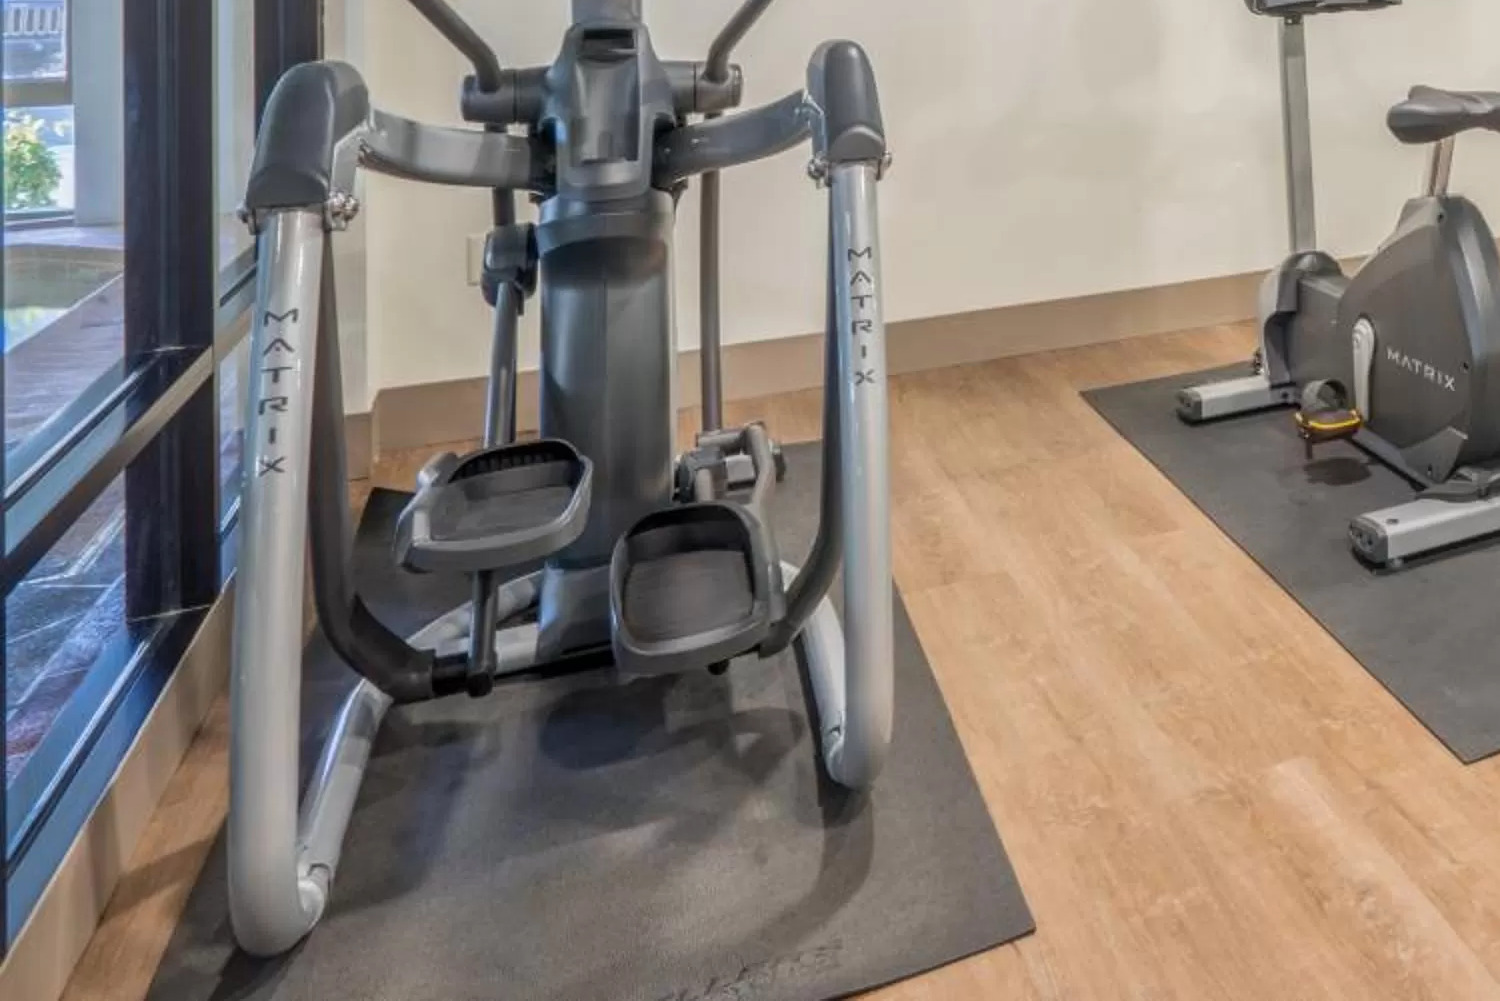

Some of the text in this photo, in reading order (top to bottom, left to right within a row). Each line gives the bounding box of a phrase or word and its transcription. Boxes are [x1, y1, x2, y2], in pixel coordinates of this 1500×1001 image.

[848, 246, 875, 386] MATRIX
[1386, 346, 1457, 392] MATRIX
[258, 307, 299, 477] MATRIX
